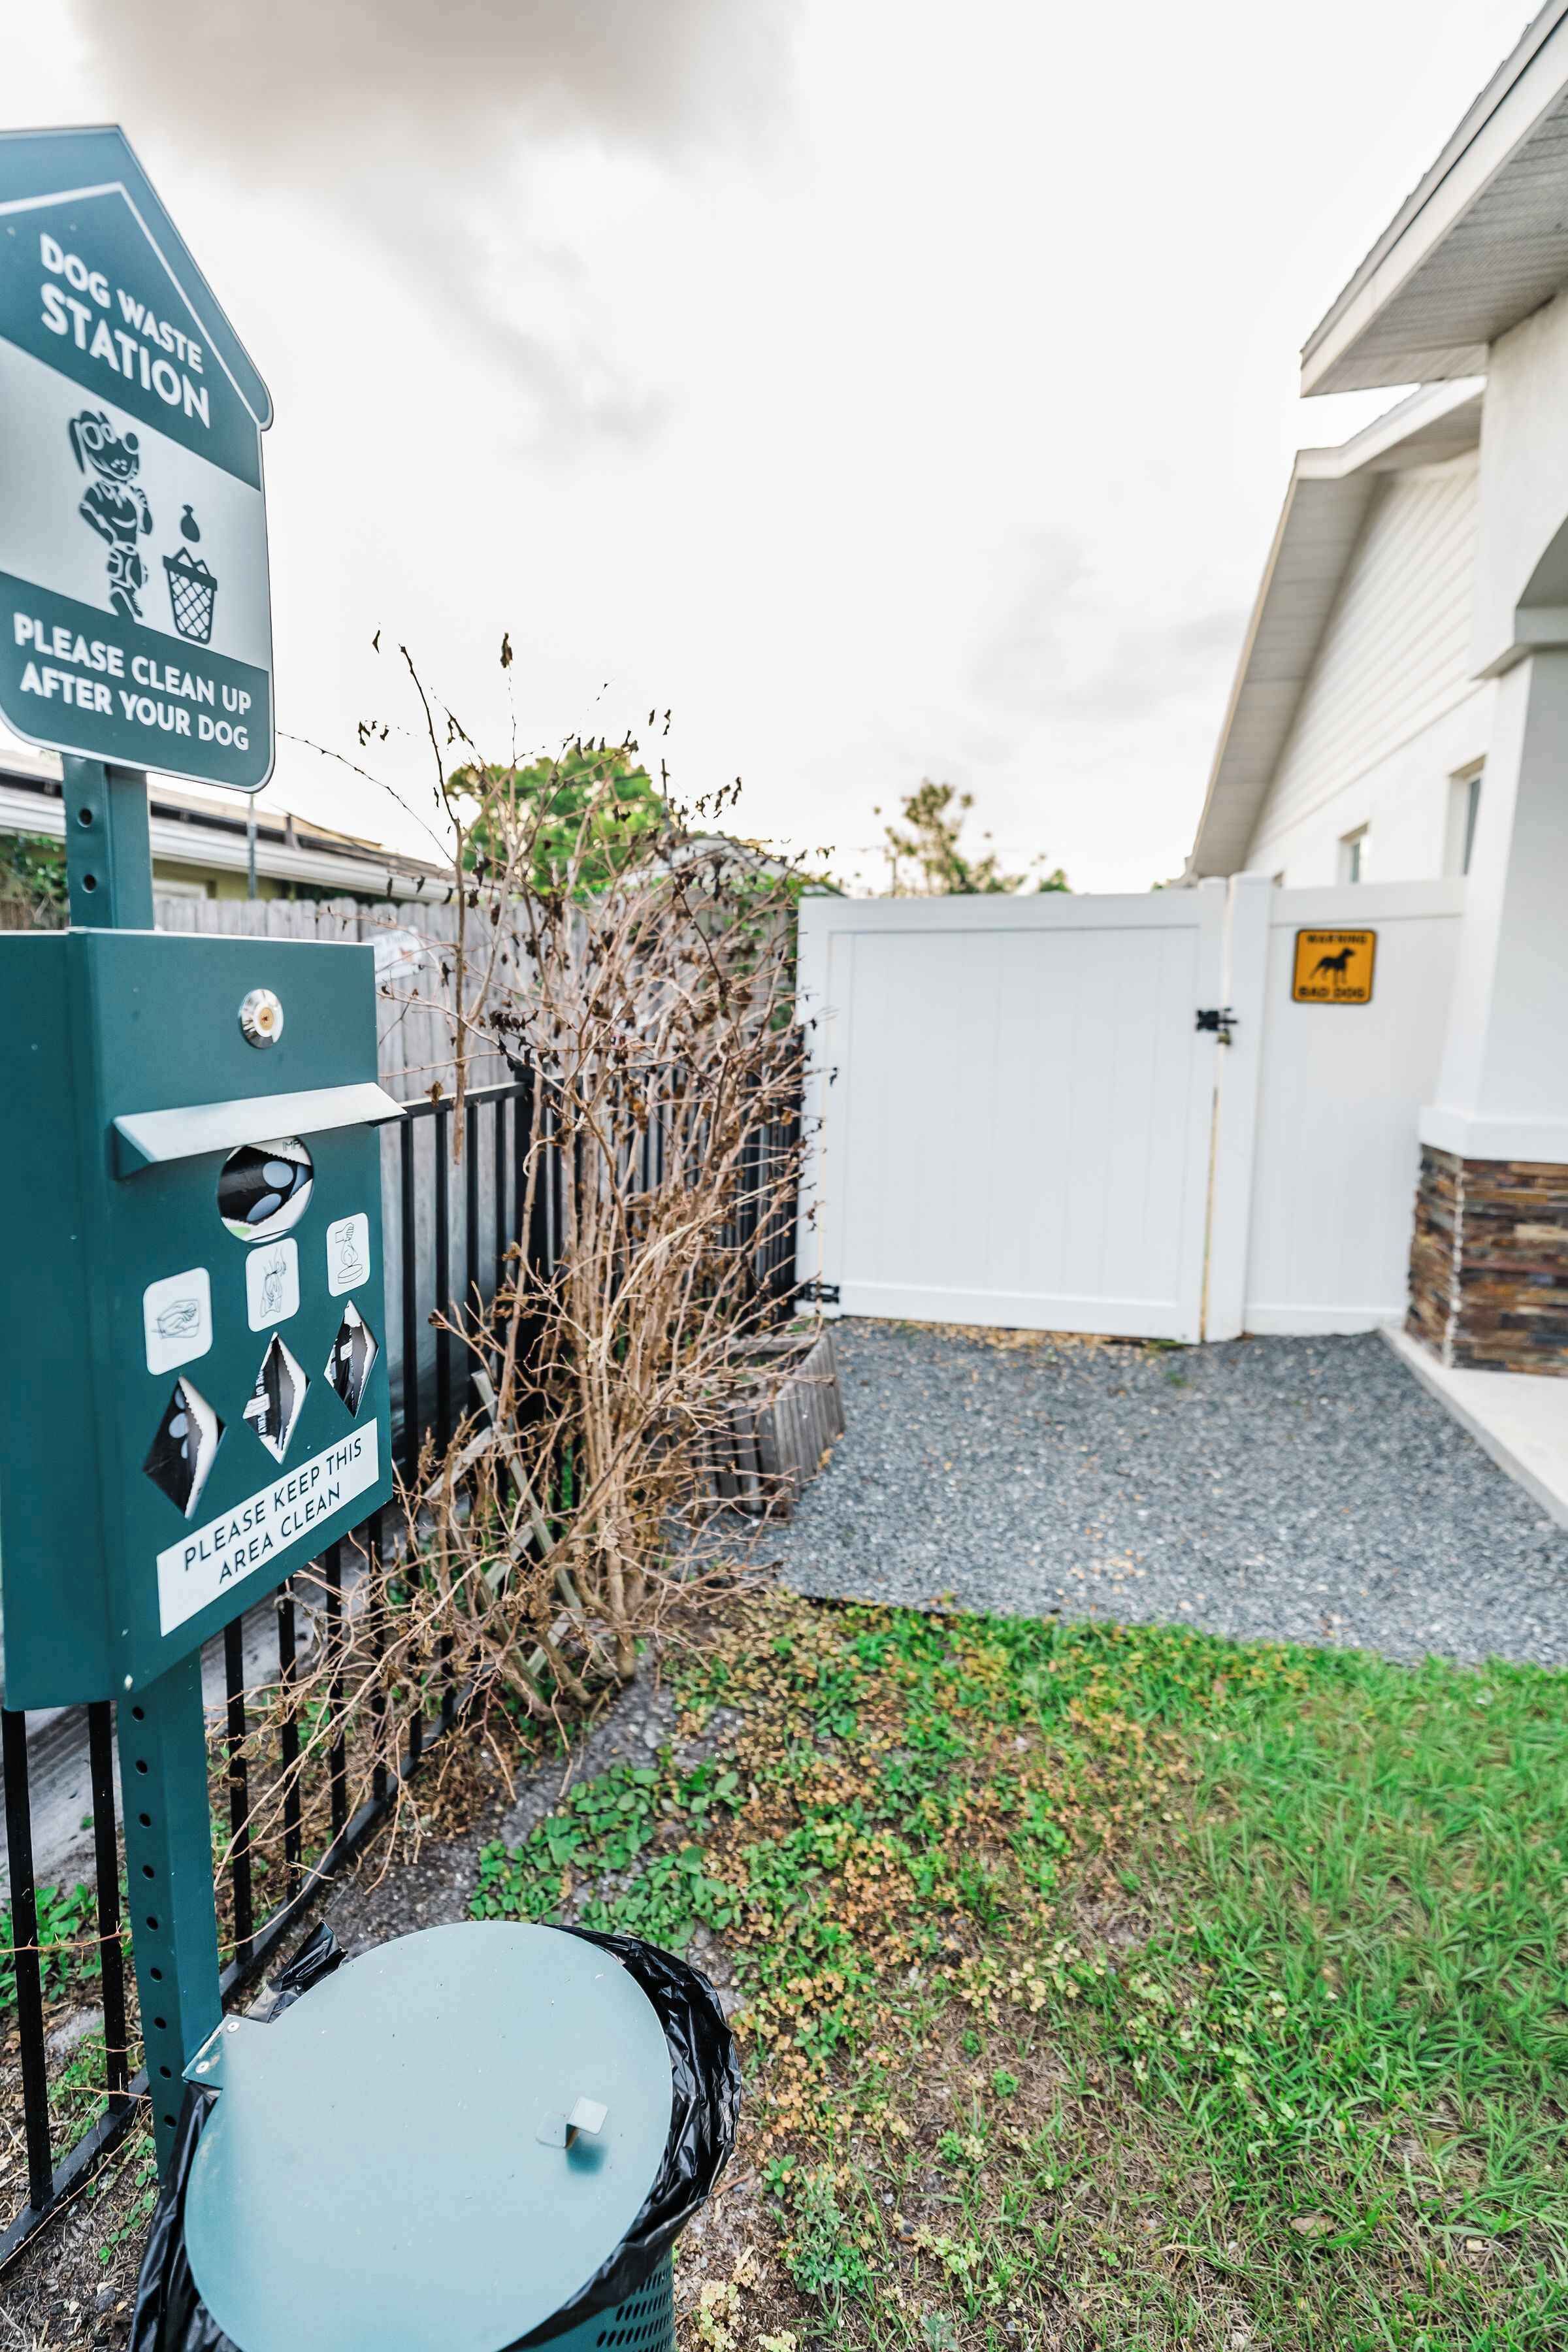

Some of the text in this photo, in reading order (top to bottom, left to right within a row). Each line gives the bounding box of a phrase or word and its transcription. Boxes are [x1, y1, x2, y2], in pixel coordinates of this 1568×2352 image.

[40, 233, 203, 374] DOG WASTE
[41, 282, 210, 429] STATION
[13, 612, 252, 715] PLEASE CLEAN UP
[20, 661, 250, 751] AFTER YOUR DOG
[183, 1437, 362, 1572] PLEASE KEEP THIS
[219, 1482, 340, 1584] AREA CLEAN
